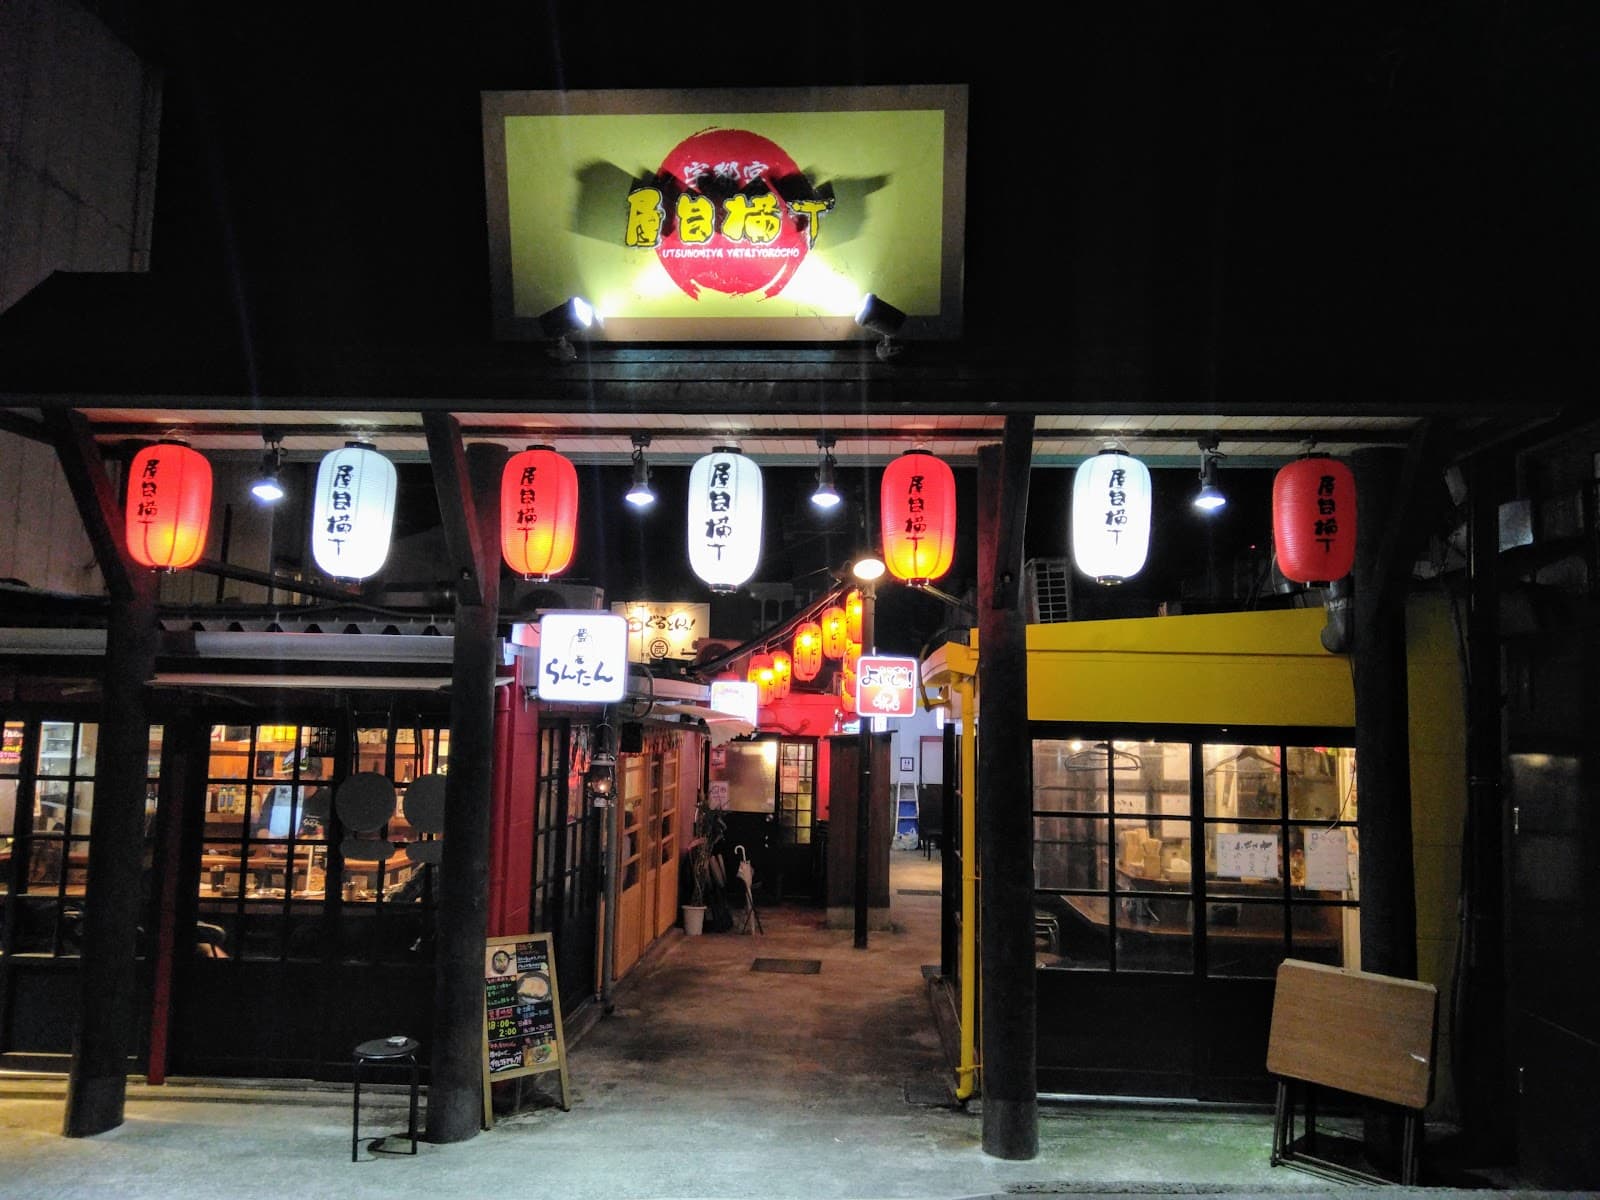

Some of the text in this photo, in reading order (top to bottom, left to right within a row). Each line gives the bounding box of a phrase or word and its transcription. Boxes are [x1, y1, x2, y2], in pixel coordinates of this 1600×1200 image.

[662, 248, 723, 259] UTSUNOMIYA
[545, 658, 614, 686] らんたん
[498, 1027, 517, 1038] 2:00
